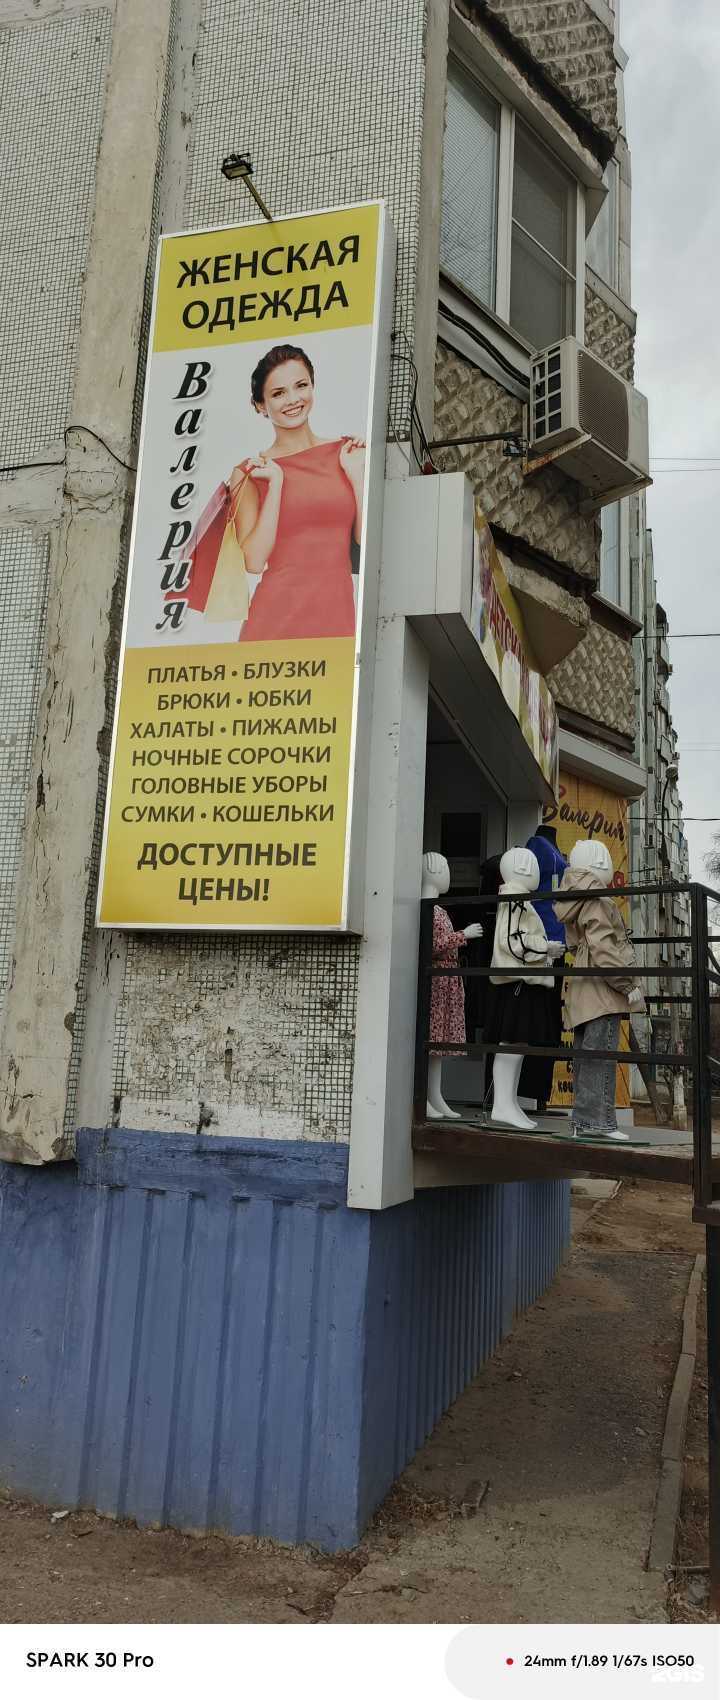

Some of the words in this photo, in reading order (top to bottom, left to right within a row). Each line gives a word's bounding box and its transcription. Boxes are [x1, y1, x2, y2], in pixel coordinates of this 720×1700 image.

[177, 235, 360, 288] ЖЕНСКАЯ
[183, 281, 349, 333] ОДЕЖДА
[155, 360, 211, 631] Валерия
[147, 664, 226, 683] ПЛАТЬЯ
[243, 660, 326, 679] БЛУЗКИ
[157, 692, 230, 710] БРЮКИ
[248, 689, 312, 707] ЮБКИ
[130, 721, 214, 738] ХАЛАТЫ
[232, 717, 336, 736] ПИЖАМЫ
[132, 748, 221, 766] НОЧНЫЕ
[227, 746, 331, 764] СОРОЧКИ
[131, 777, 246, 794] ГОЛОВНЫЕ
[252, 775, 327, 793] УБОРЫ
[121, 806, 194, 823] СУМКИ
[212, 804, 334, 822] КОШЕЛЬКИ
[137, 843, 317, 869] ДОСТУПНЫЕ
[178, 878, 269, 905] ЦЕНЫ!
